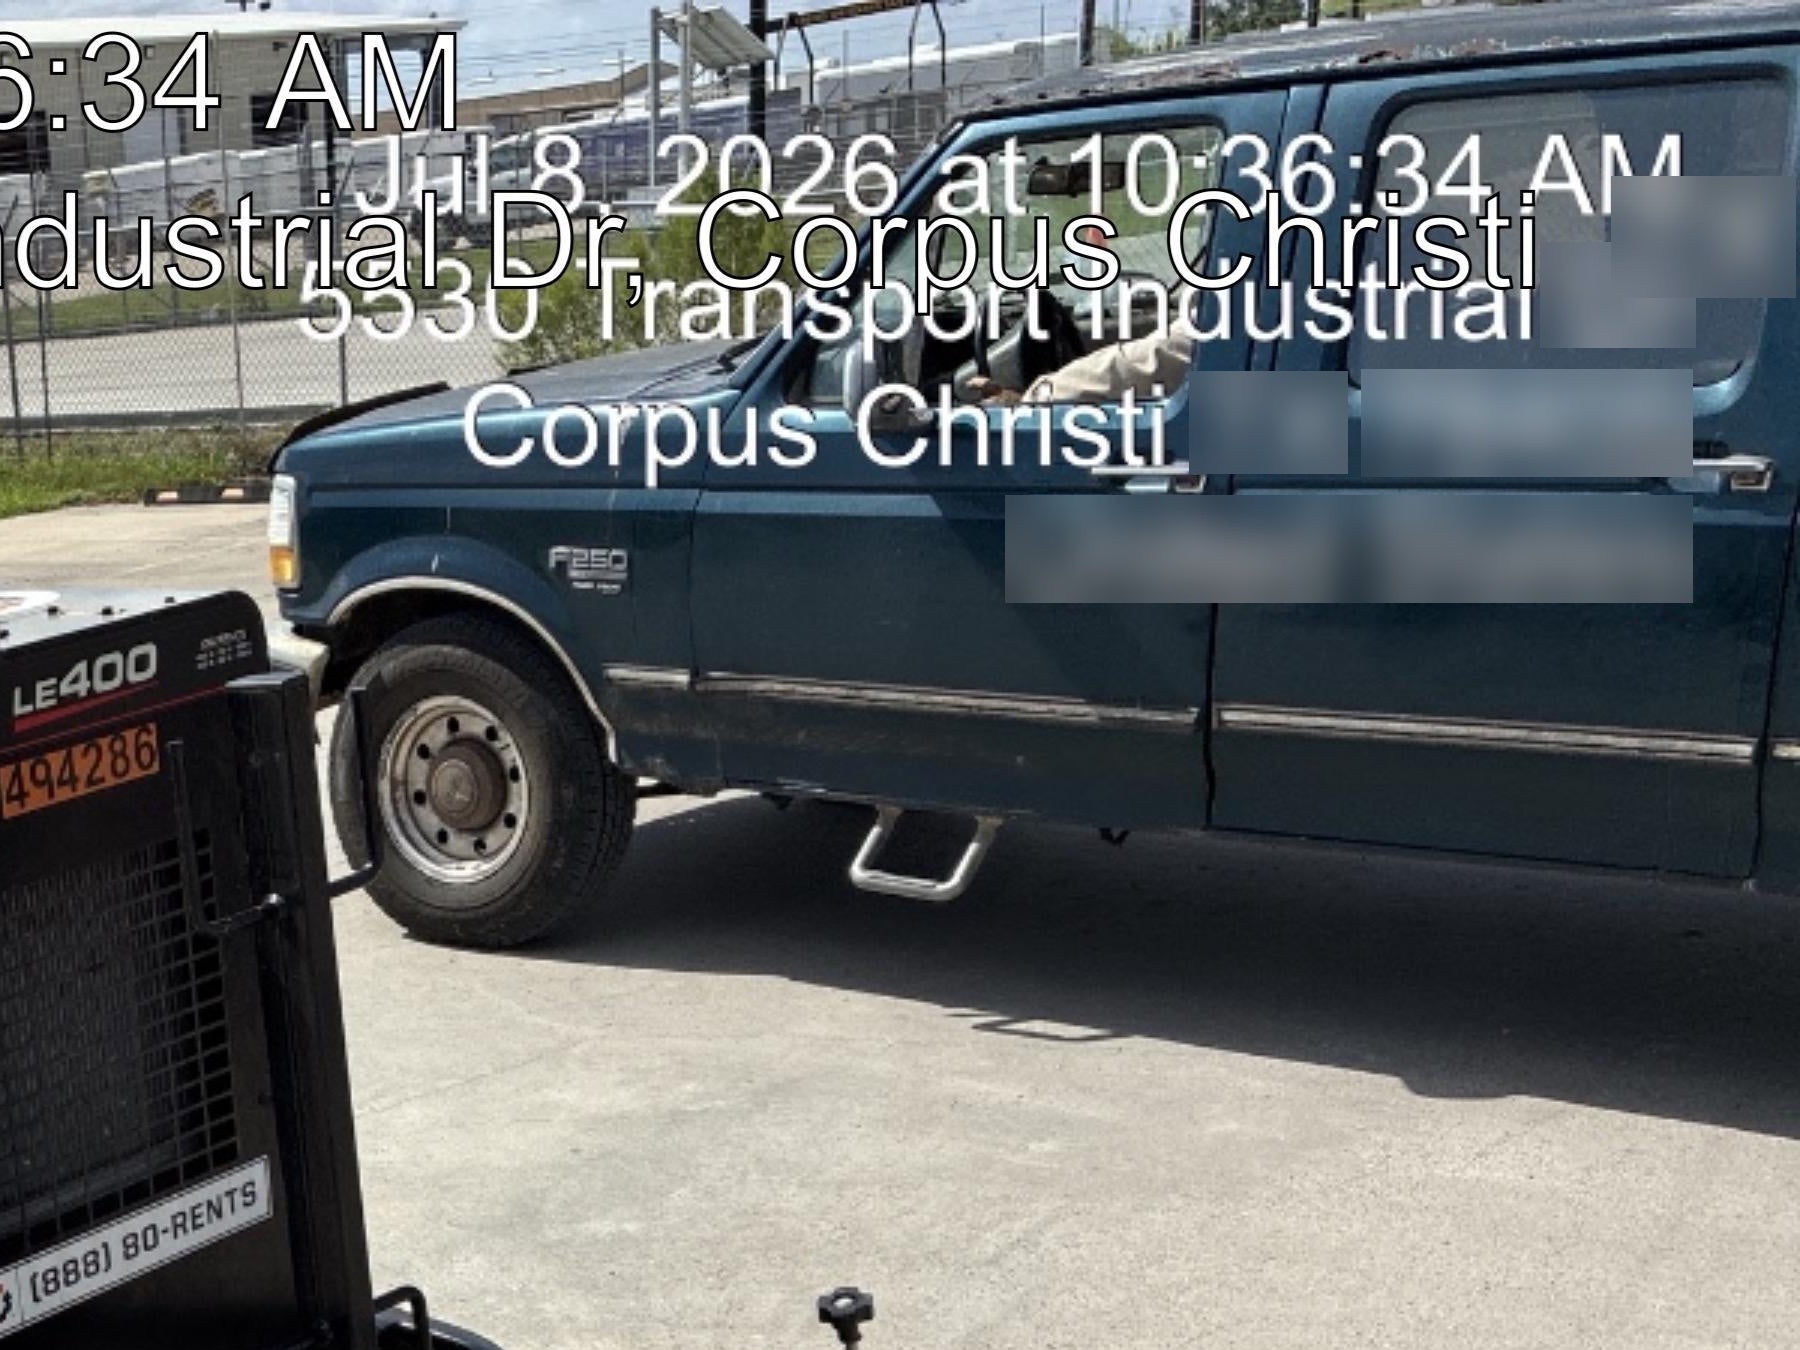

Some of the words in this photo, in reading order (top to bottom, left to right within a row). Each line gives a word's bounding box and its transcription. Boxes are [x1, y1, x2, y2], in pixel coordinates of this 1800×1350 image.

[548, 545, 629, 571] F250
[12, 640, 158, 717] LE400
[3, 727, 158, 809] 494286
[29, 1241, 112, 1302] (888)
[121, 1180, 258, 1262] 80-RENTS
